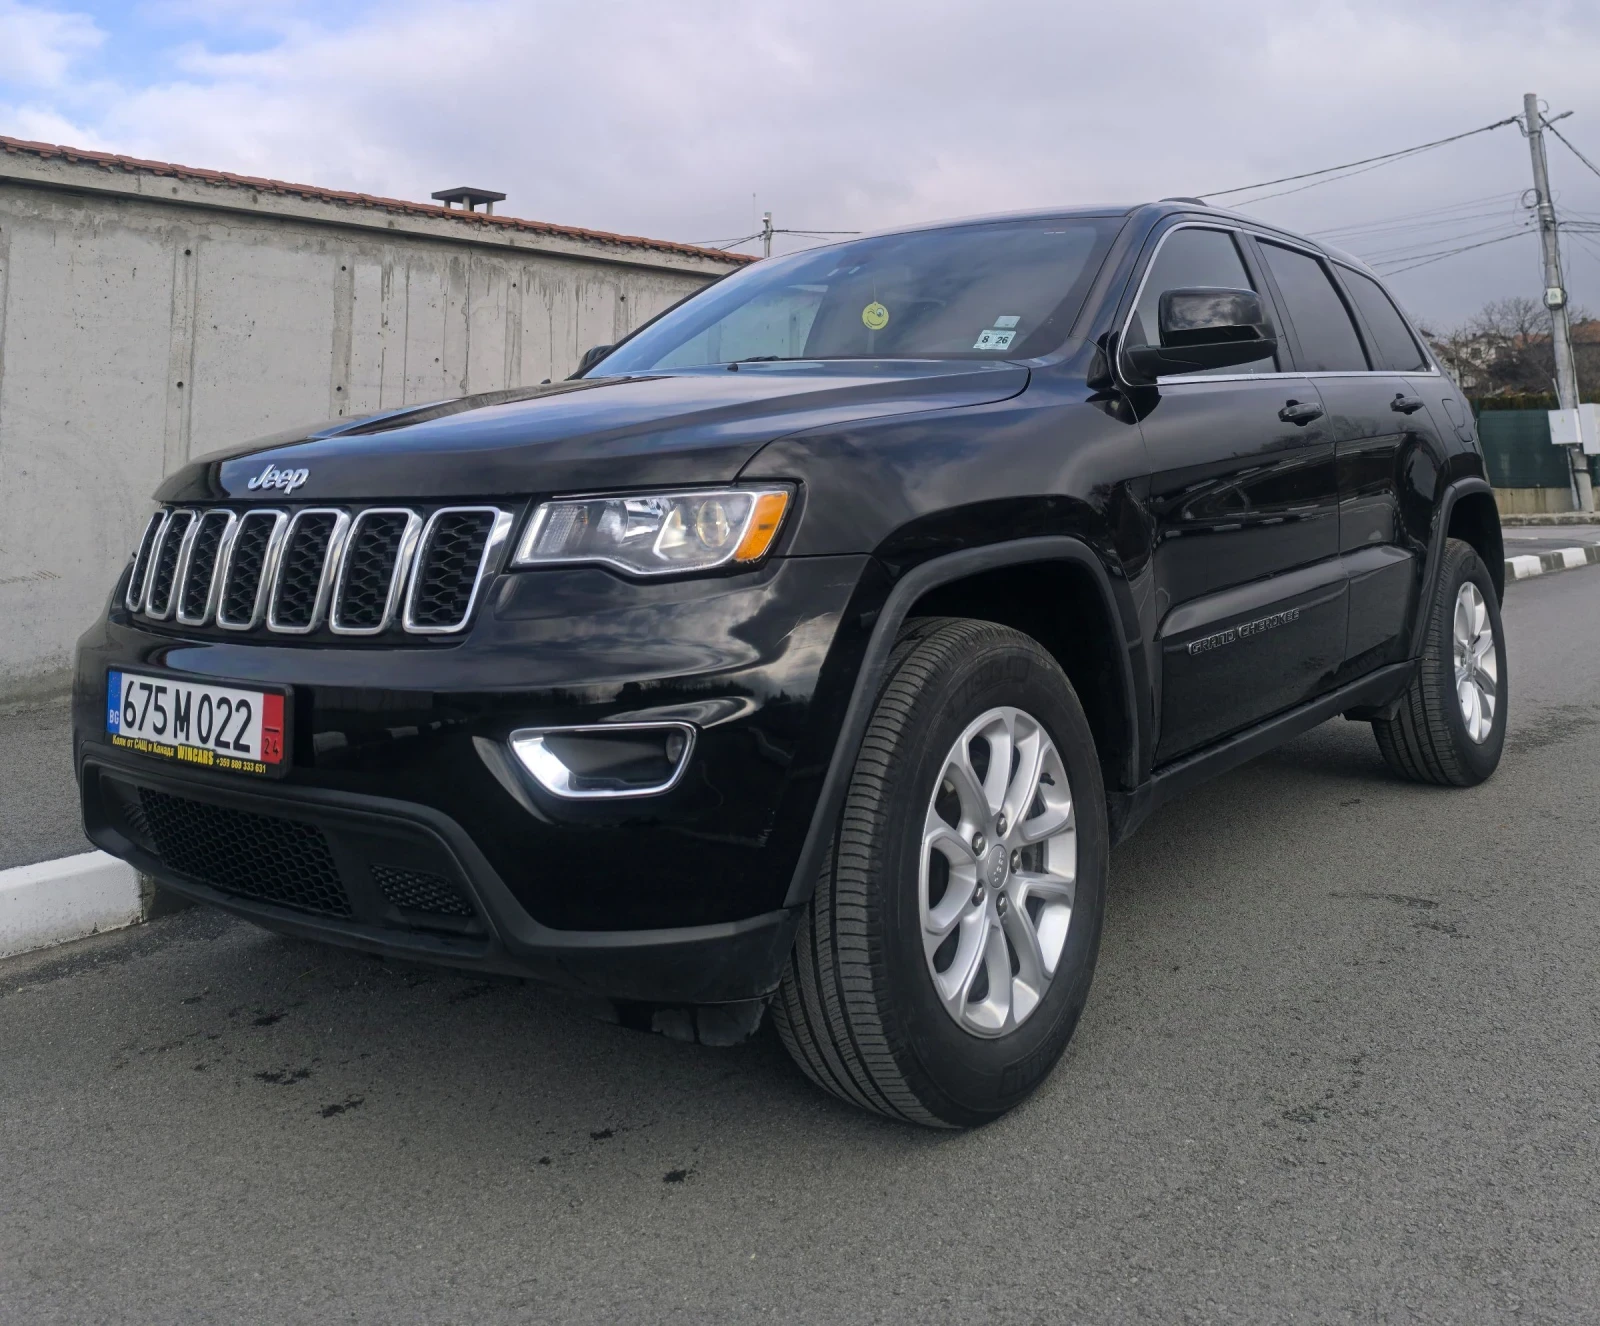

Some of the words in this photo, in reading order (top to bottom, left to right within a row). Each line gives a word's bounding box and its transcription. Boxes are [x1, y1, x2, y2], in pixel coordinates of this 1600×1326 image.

[981, 335, 990, 344] 8
[995, 336, 1009, 344] 26
[247, 464, 309, 495] Jeep
[1188, 629, 1236, 655] GRAND
[1238, 607, 1300, 638] CHEROKEE
[109, 709, 120, 725] BG
[177, 745, 213, 765] WINCARS
